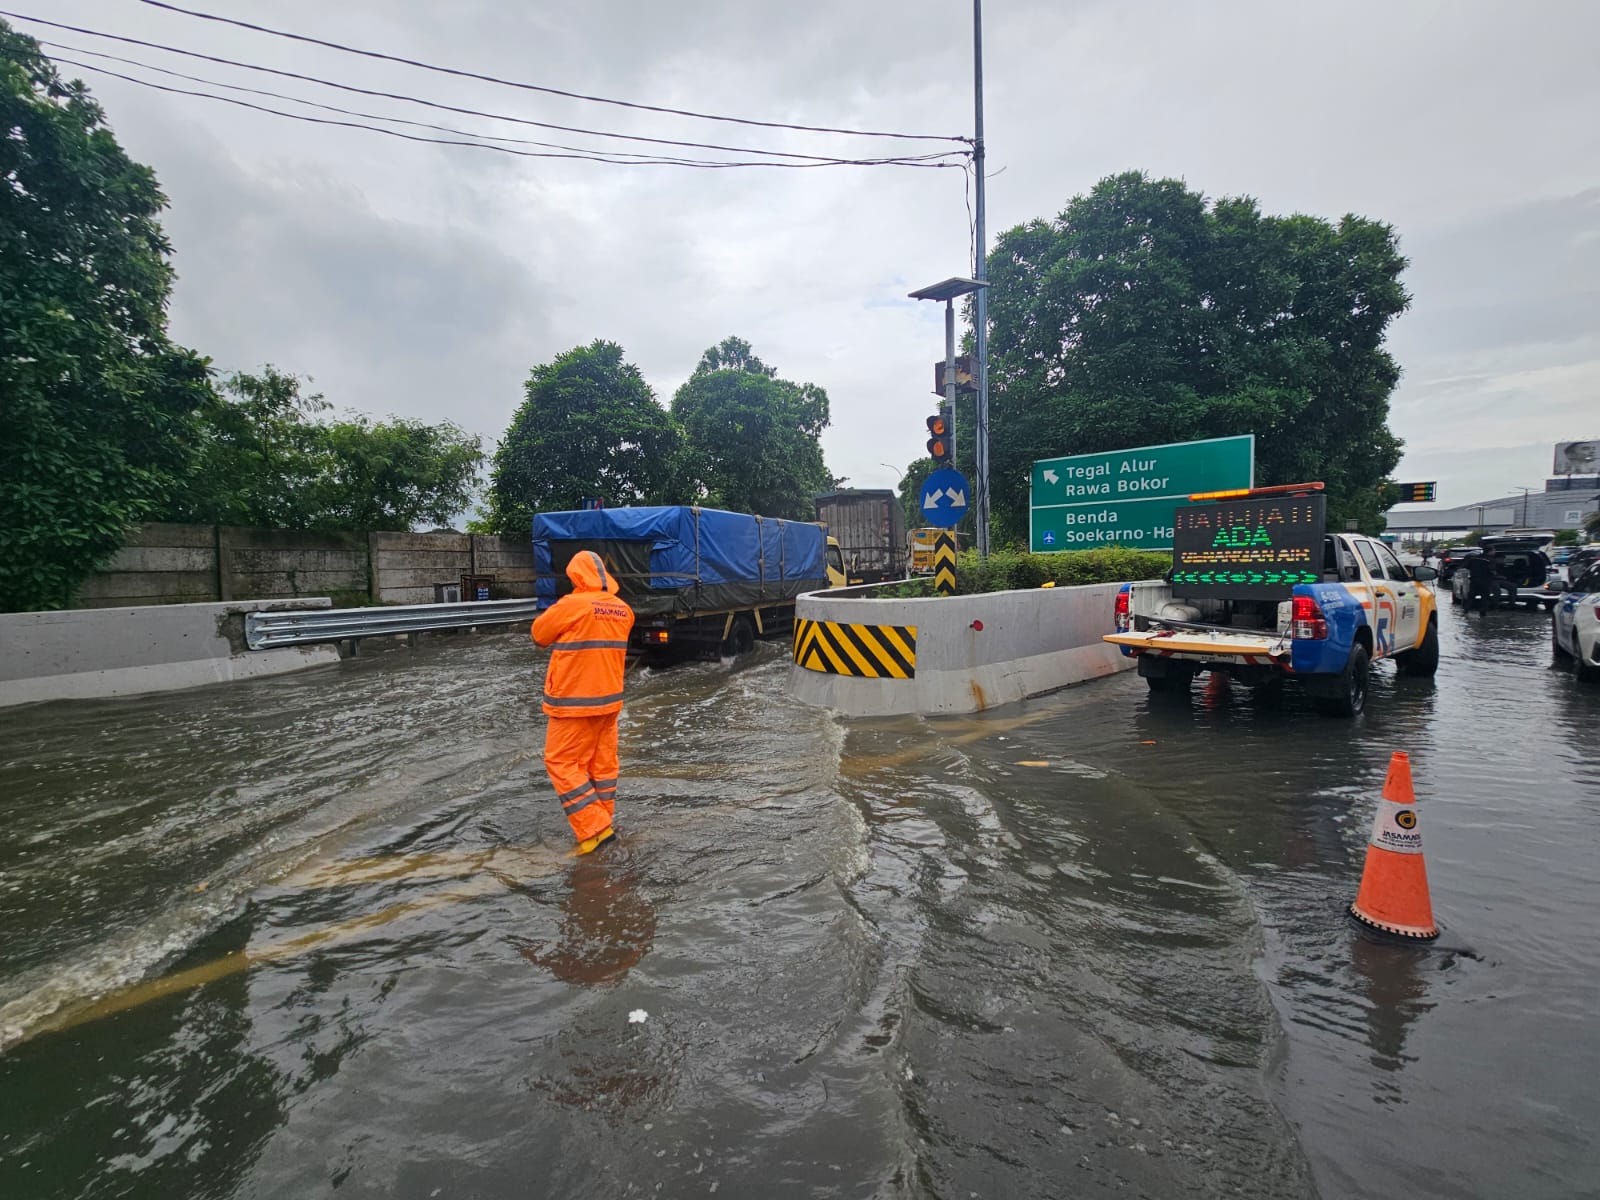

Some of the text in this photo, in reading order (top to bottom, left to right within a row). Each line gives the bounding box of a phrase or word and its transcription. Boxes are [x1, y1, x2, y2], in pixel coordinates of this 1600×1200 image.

[1066, 459, 1157, 480] Tegal Alur
[1066, 477, 1170, 497] Rawa Bokor
[1066, 510, 1118, 525] Benda
[1212, 525, 1272, 547] ADA
